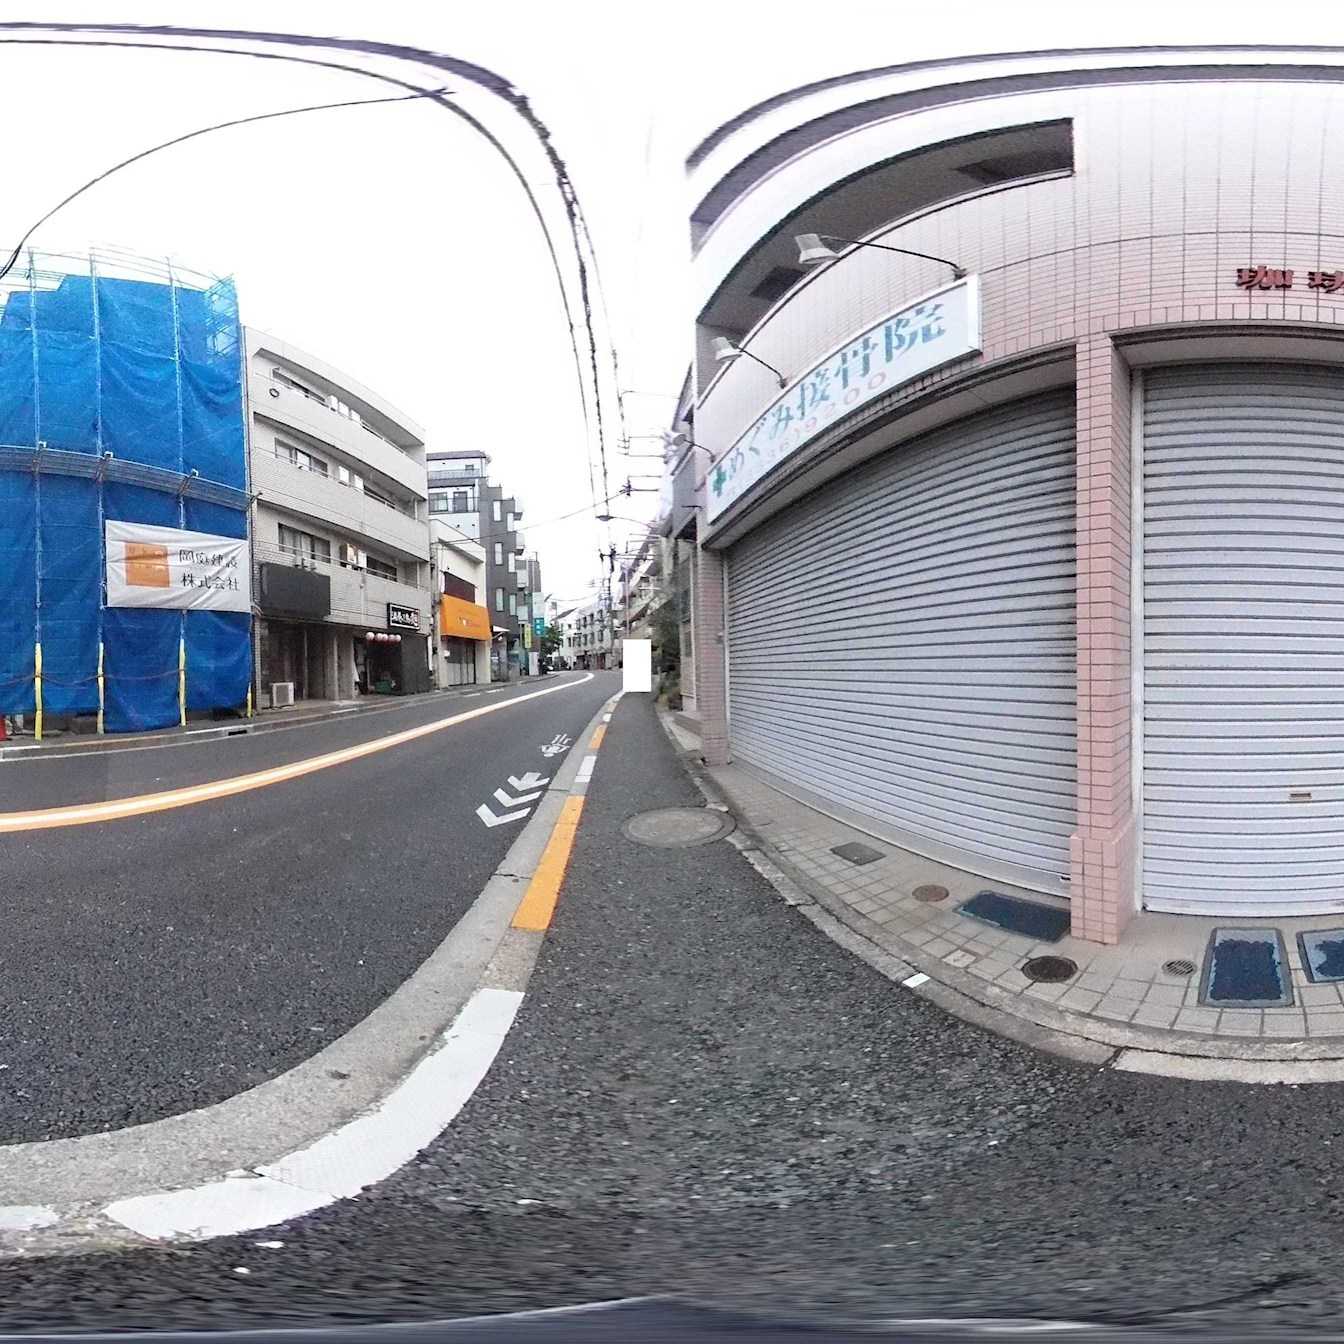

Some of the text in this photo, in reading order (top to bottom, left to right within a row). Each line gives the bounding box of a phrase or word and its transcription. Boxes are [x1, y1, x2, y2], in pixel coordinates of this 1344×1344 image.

[727, 302, 946, 480] めぐみ接骨院
[181, 571, 240, 592] 株式会社
